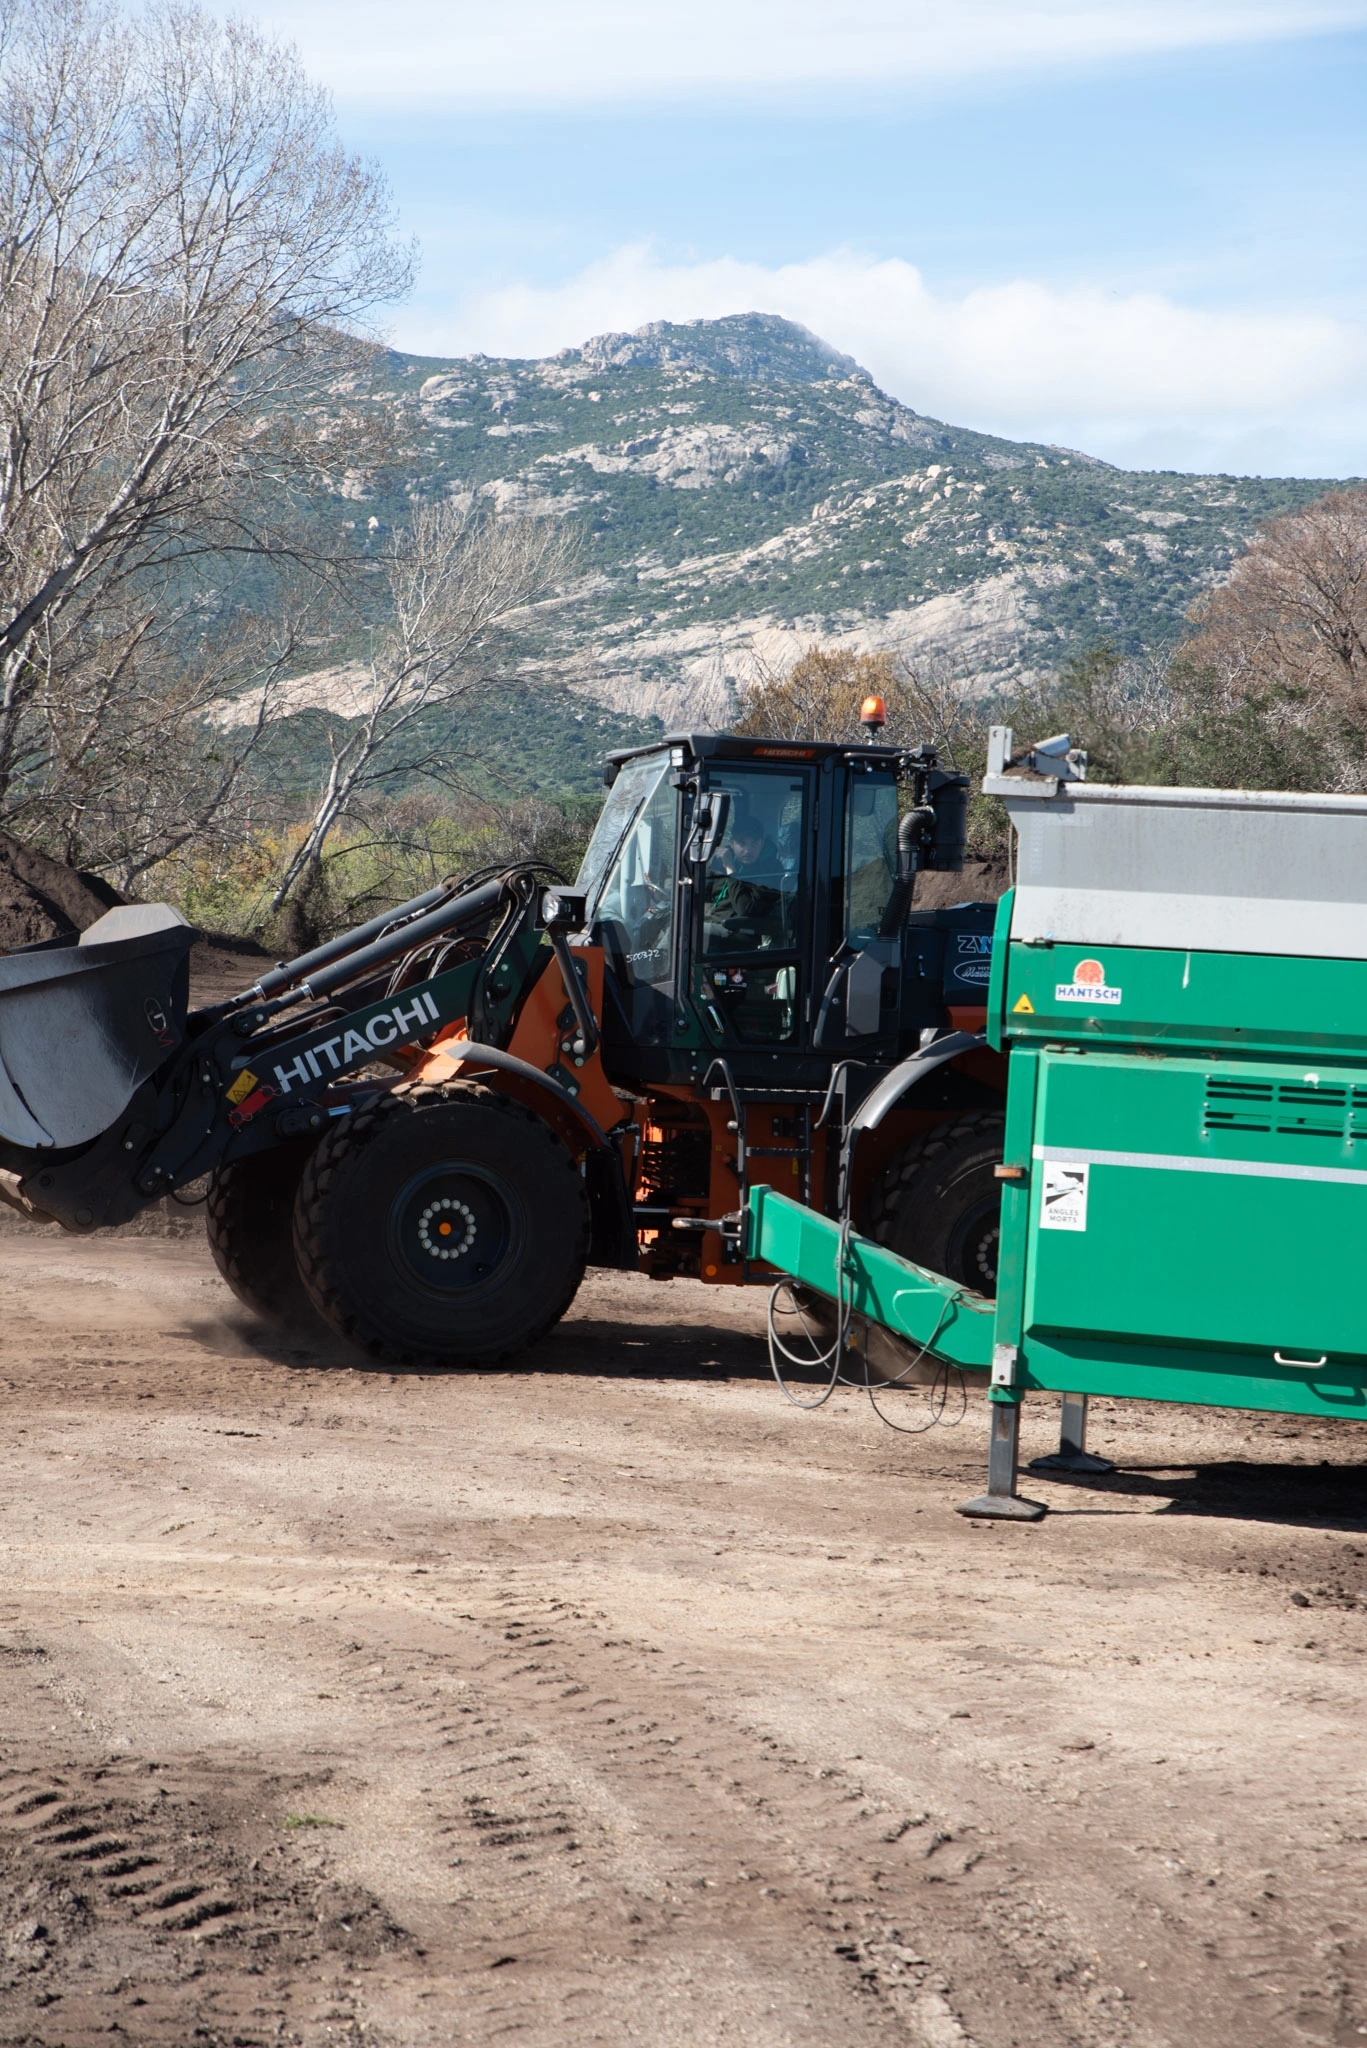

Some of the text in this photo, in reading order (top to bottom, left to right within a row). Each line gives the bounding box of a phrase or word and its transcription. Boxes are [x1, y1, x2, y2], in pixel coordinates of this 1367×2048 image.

[1058, 987, 1120, 1000] HANTSCH
[273, 991, 440, 1094] HITACHI
[1048, 1208, 1079, 1216] ANGLES
[1049, 1215, 1077, 1223] MORTS
